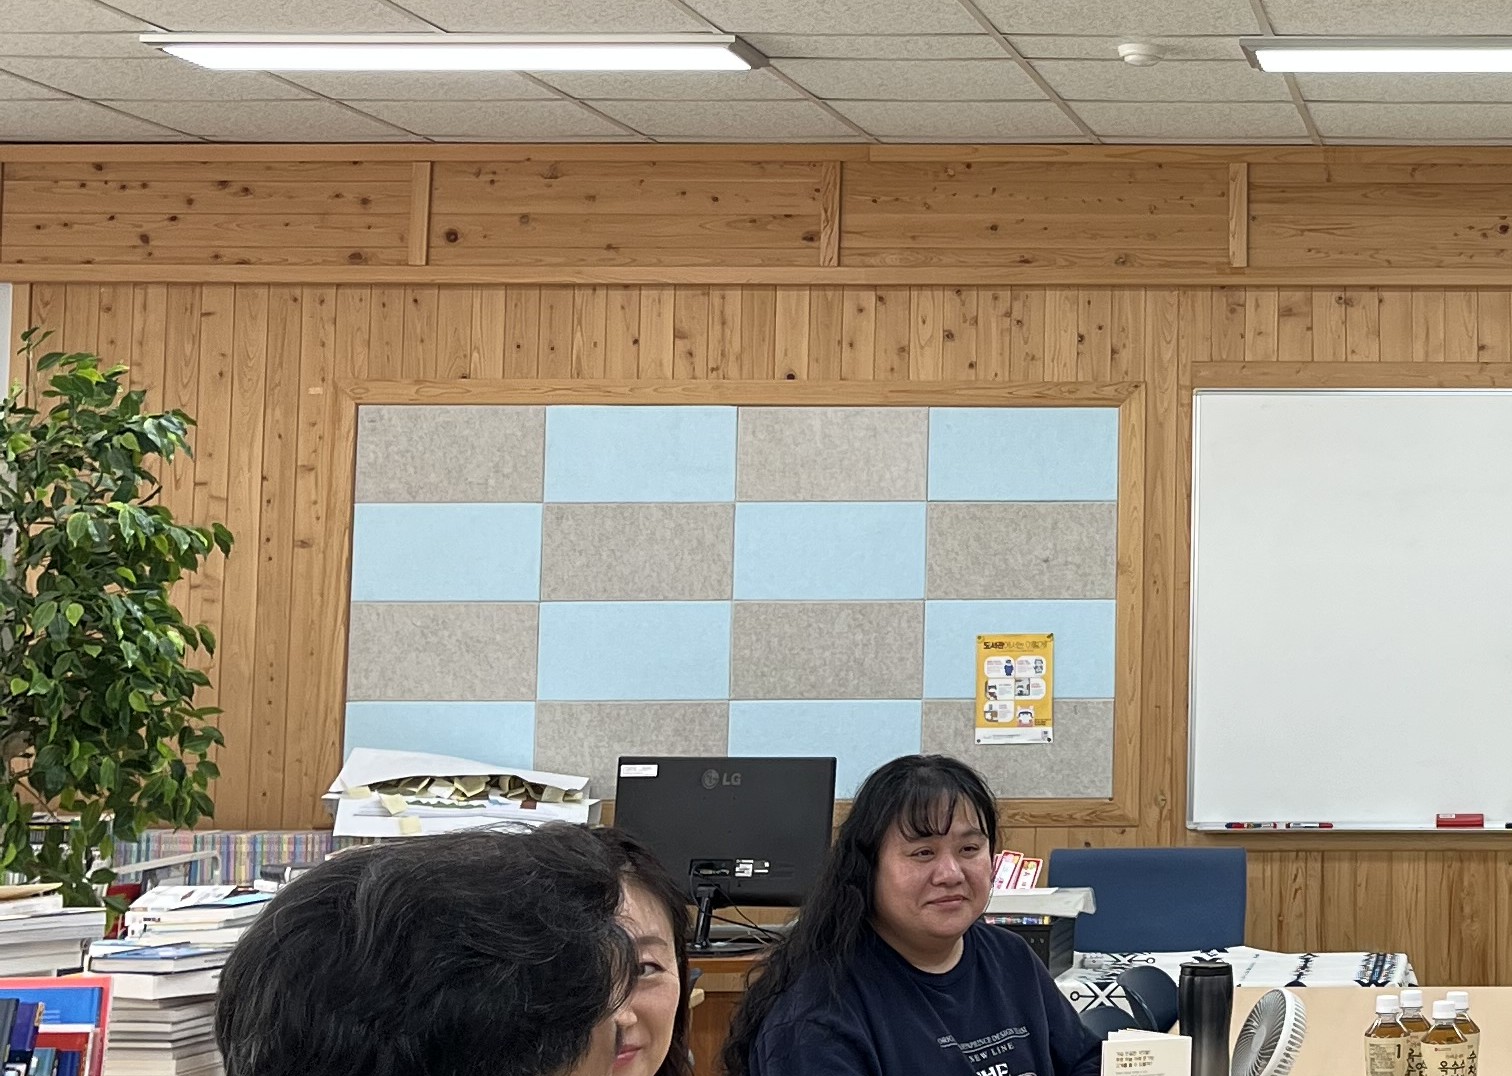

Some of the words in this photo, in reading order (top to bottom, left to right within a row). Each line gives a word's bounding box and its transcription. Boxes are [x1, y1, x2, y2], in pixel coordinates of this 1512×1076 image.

[721, 773, 741, 786] LG
[968, 1051, 988, 1063] NEW
[992, 1042, 1015, 1057] LINE
